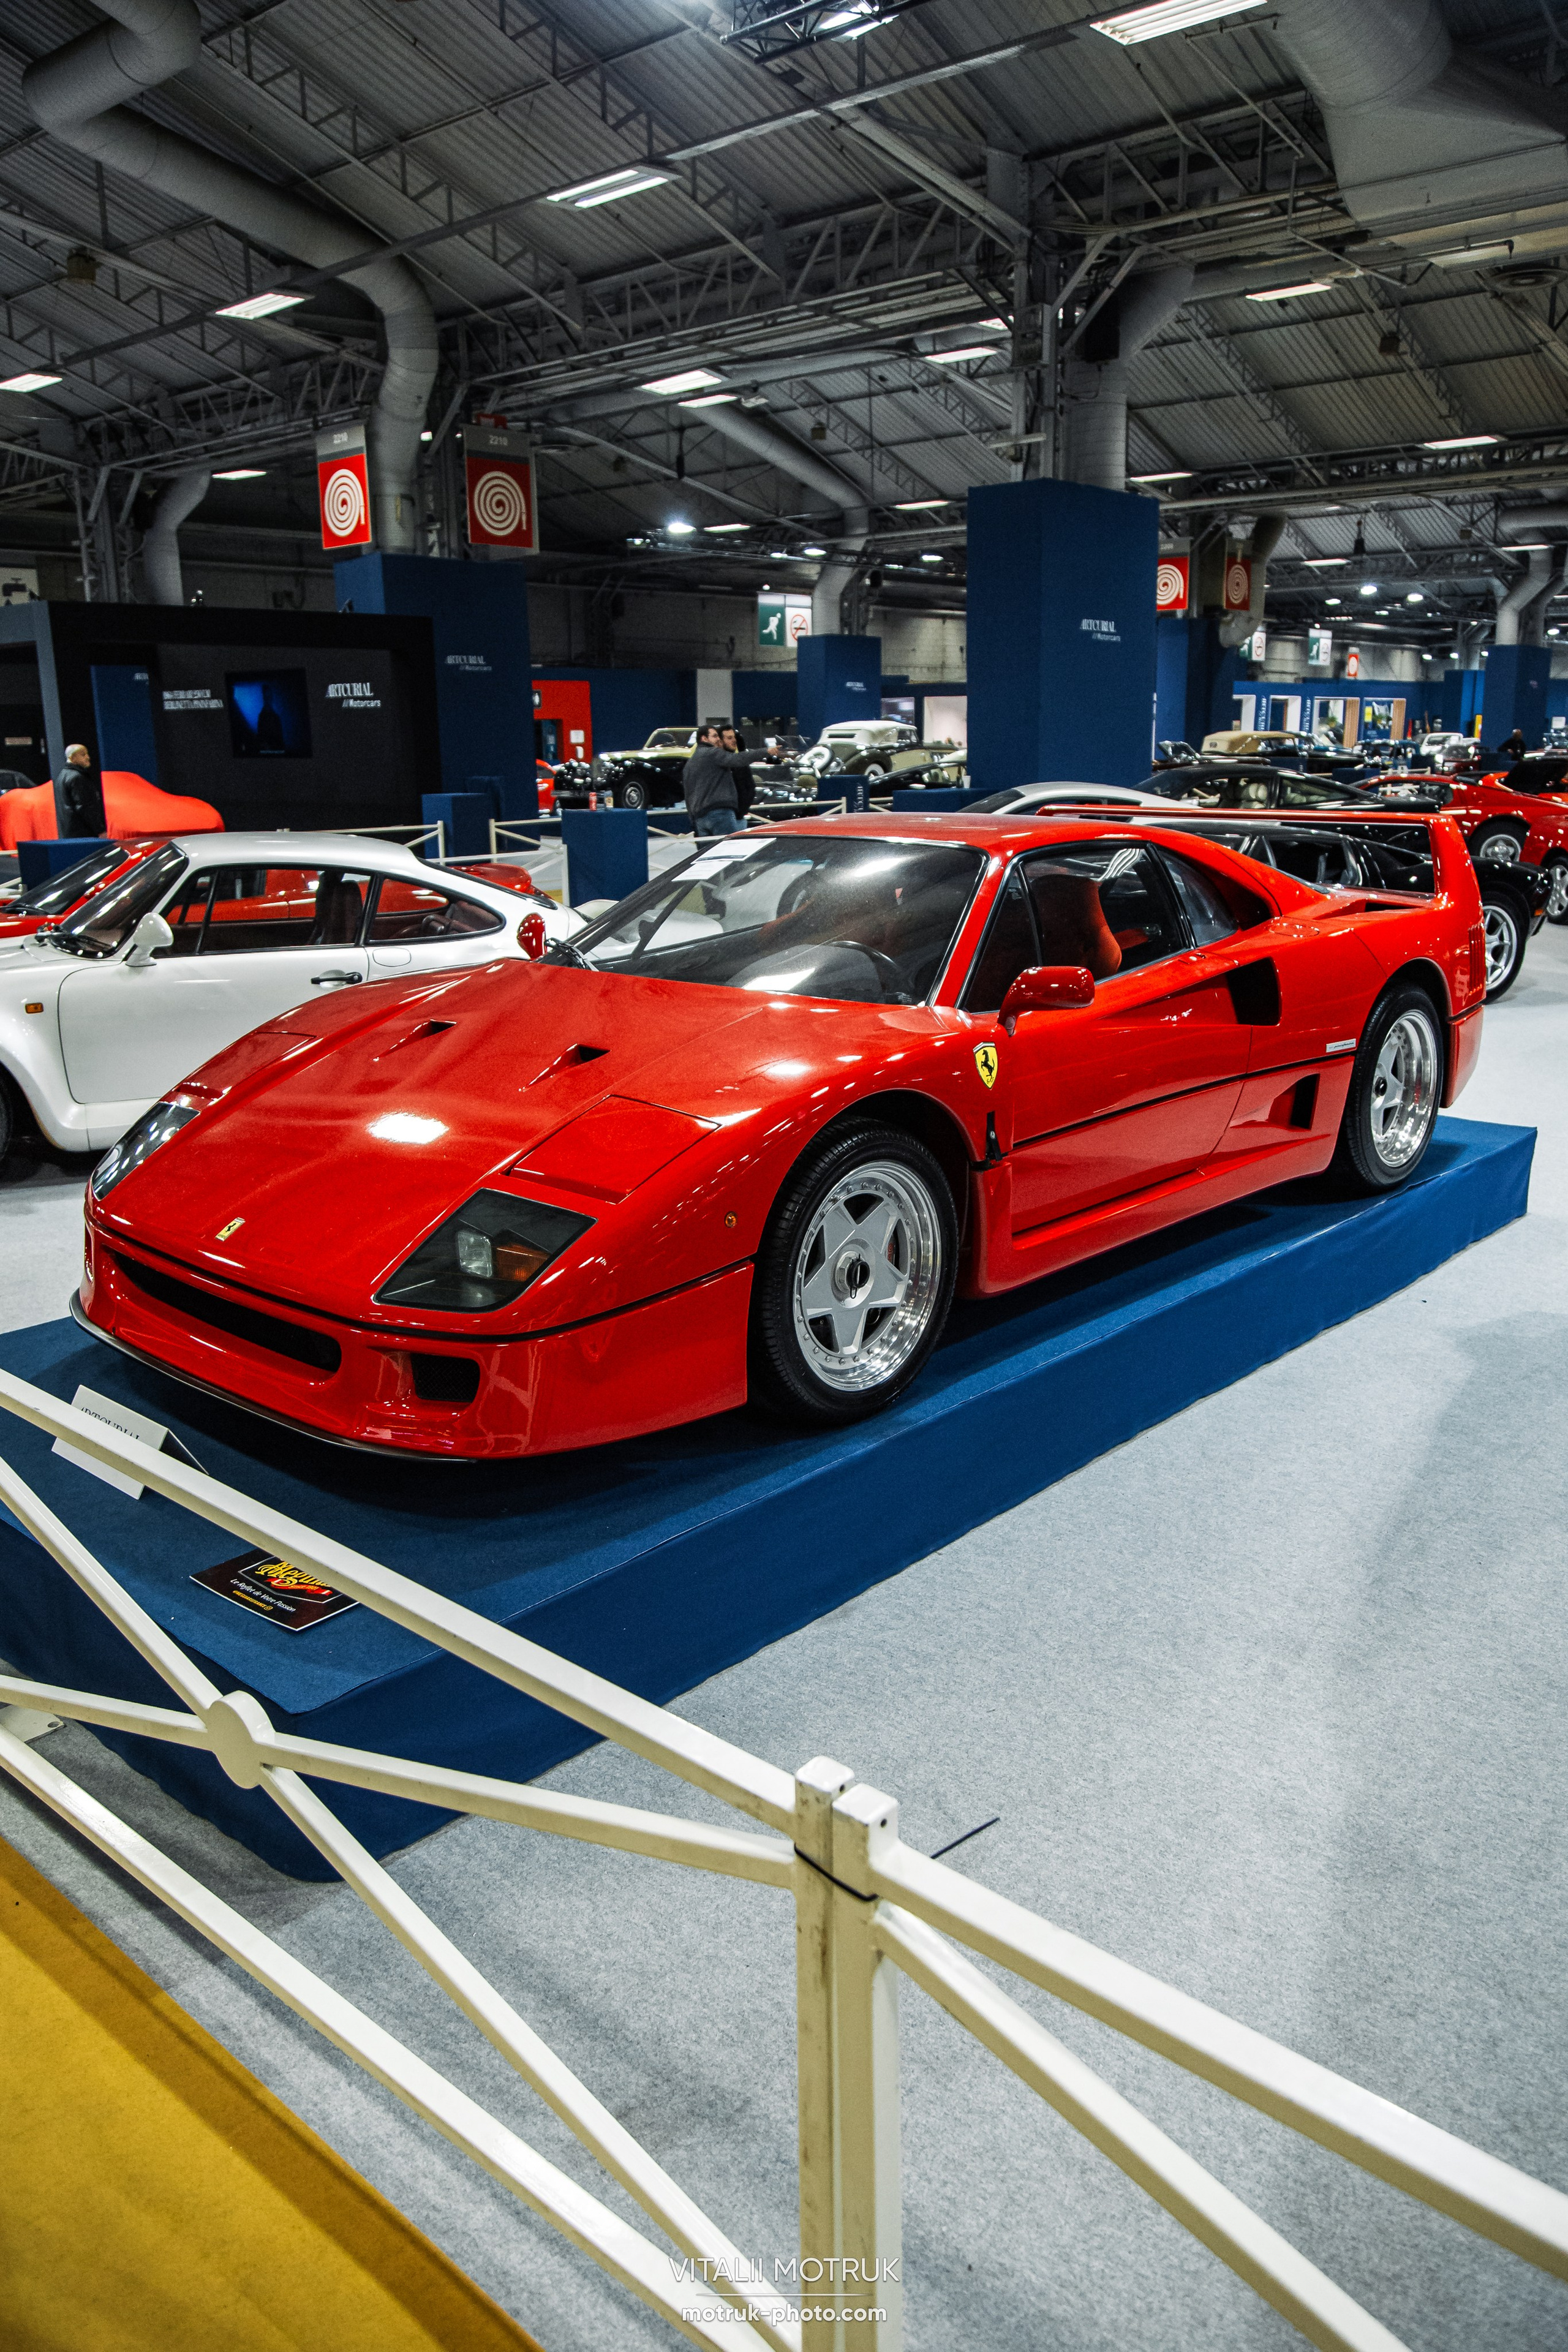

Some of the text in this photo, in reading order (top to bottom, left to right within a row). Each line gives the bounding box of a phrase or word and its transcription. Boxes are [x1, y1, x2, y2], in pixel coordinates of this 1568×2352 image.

[325, 682, 374, 697] ARTCURIAL
[237, 1583, 256, 1593] Reflet
[260, 1594, 276, 1602] Votre
[274, 1600, 296, 1612] Passion
